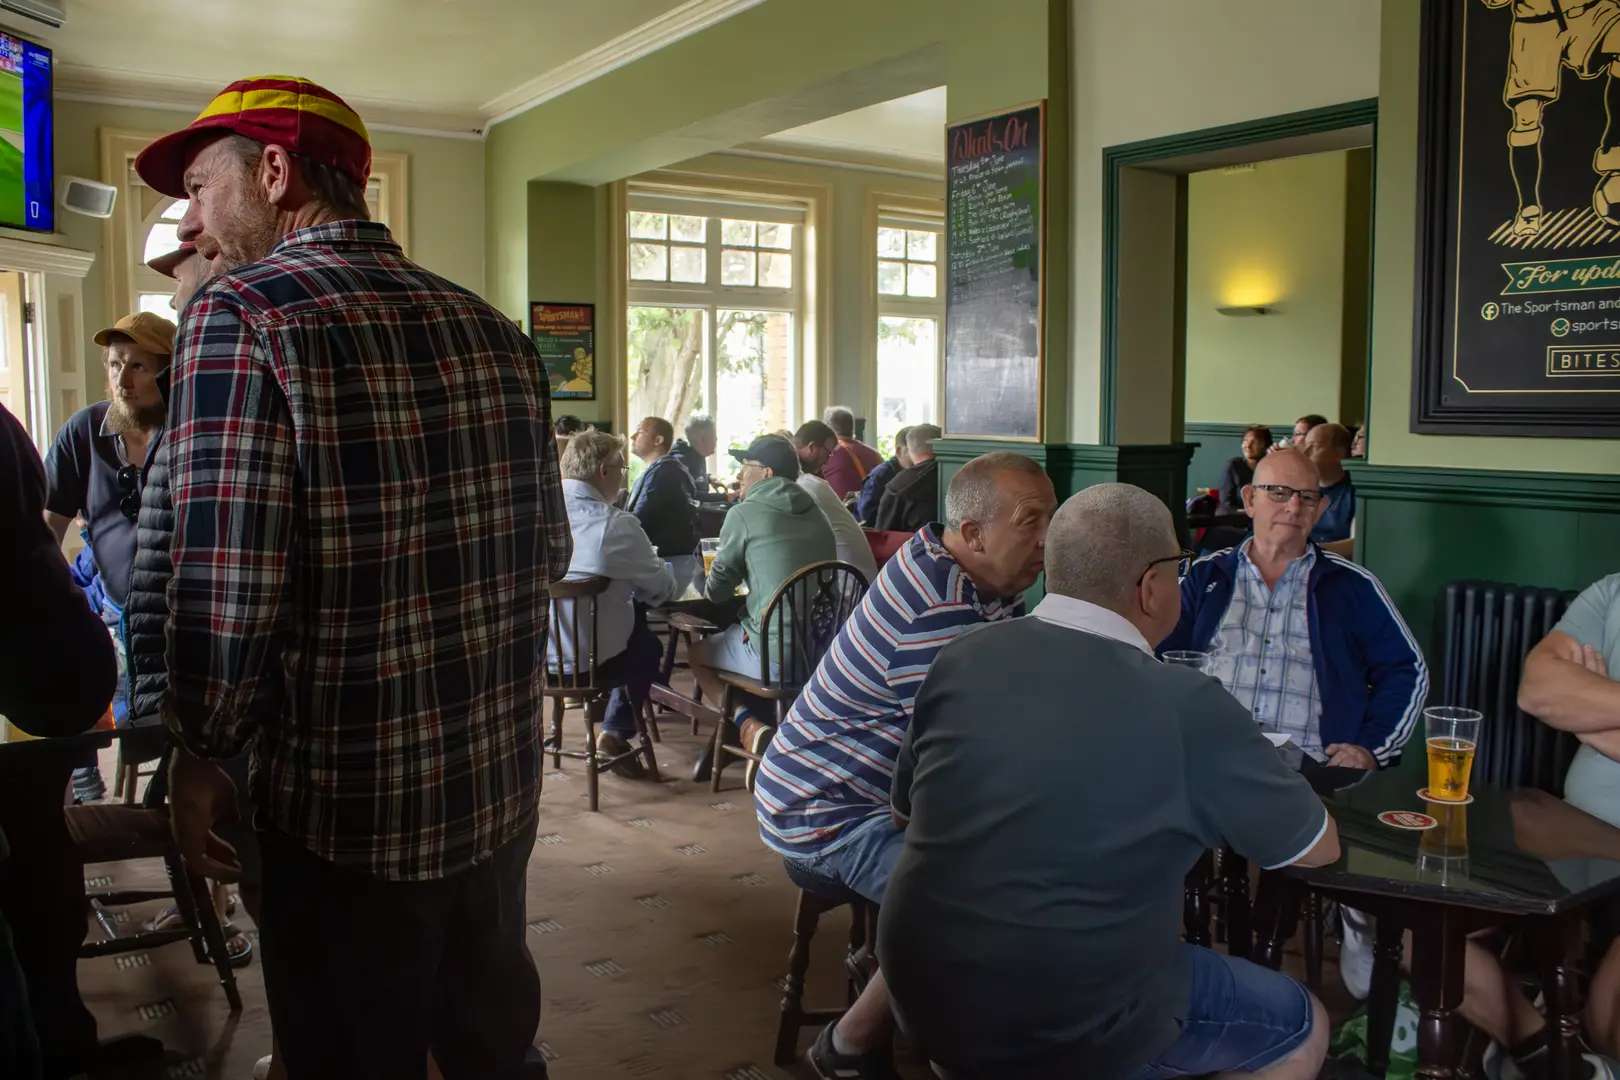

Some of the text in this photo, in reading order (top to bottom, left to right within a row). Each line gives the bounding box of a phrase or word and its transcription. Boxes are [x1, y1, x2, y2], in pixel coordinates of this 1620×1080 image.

[1004, 116, 1028, 152] On
[989, 154, 1005, 167] June
[982, 179, 996, 193] June
[1516, 265, 1569, 290] For
[1501, 302, 1522, 315] The
[1524, 299, 1596, 316] Sportsman
[1572, 318, 1620, 334] sports
[1561, 353, 1620, 369] BITES
